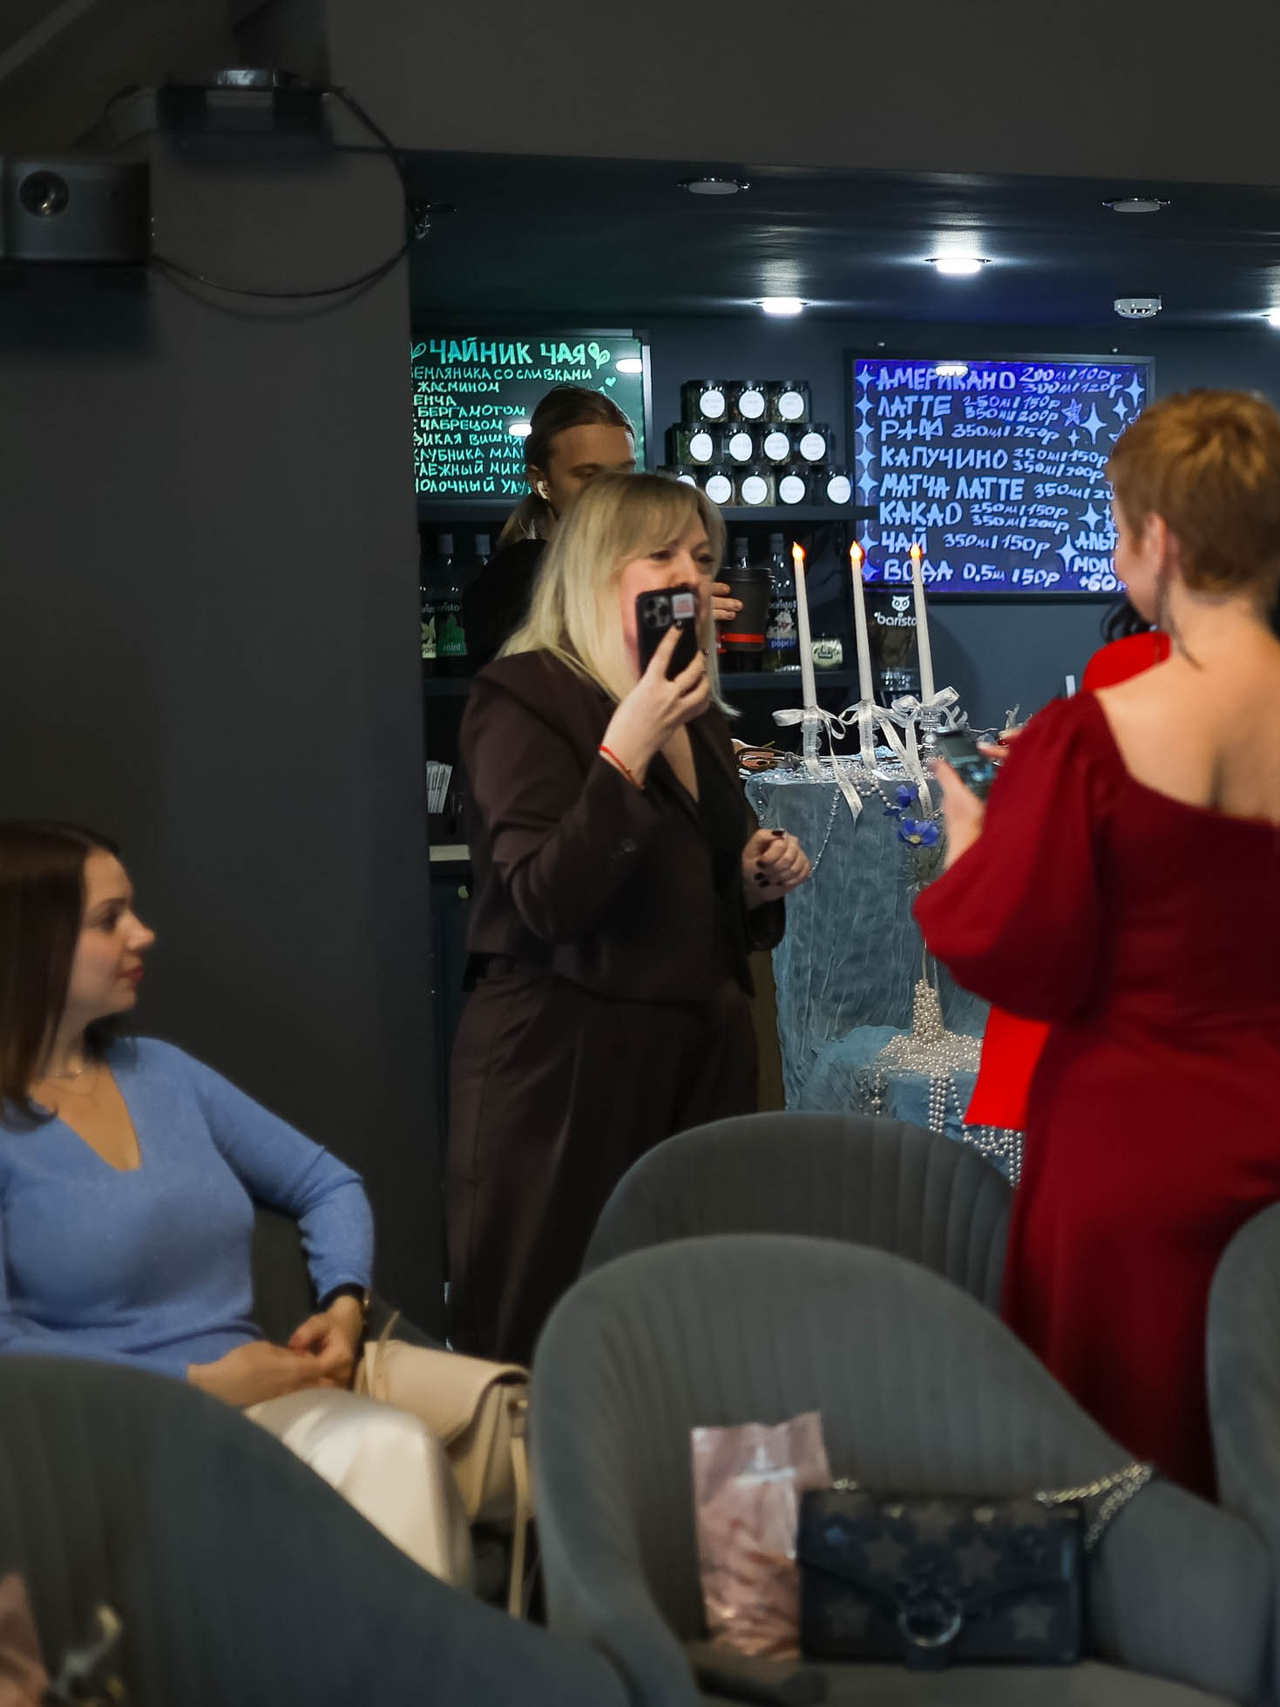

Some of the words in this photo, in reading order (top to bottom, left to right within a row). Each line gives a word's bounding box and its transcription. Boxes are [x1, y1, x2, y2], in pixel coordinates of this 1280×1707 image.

[430, 337, 533, 365] ЧАЙНИК
[540, 342, 586, 366] ЧАЯ
[411, 366, 492, 380] ЕМЛЯНИКА
[493, 369, 513, 380] СО
[516, 368, 592, 381] СЛИВКАМИ
[876, 366, 1016, 391] АМЕРИКАНО
[417, 381, 500, 393] ЖАСМИНОМ
[412, 394, 457, 406] ЕНЧА
[418, 404, 526, 418] БЕРГАМОТОМ
[877, 395, 953, 418] ЛАТТЕ
[420, 419, 503, 431] ЧАБРЕЦОМ
[880, 417, 944, 442] РАФ
[881, 445, 1009, 469] КАПУЧИНО
[415, 476, 495, 494] ОЛОЧНЫЙ
[879, 473, 951, 499] МАТЧА
[955, 476, 1025, 501] ЛАТТЕ
[879, 501, 963, 527] КАКАО
[881, 527, 927, 554] ЧАЙ
[883, 558, 953, 583] ВОДА
